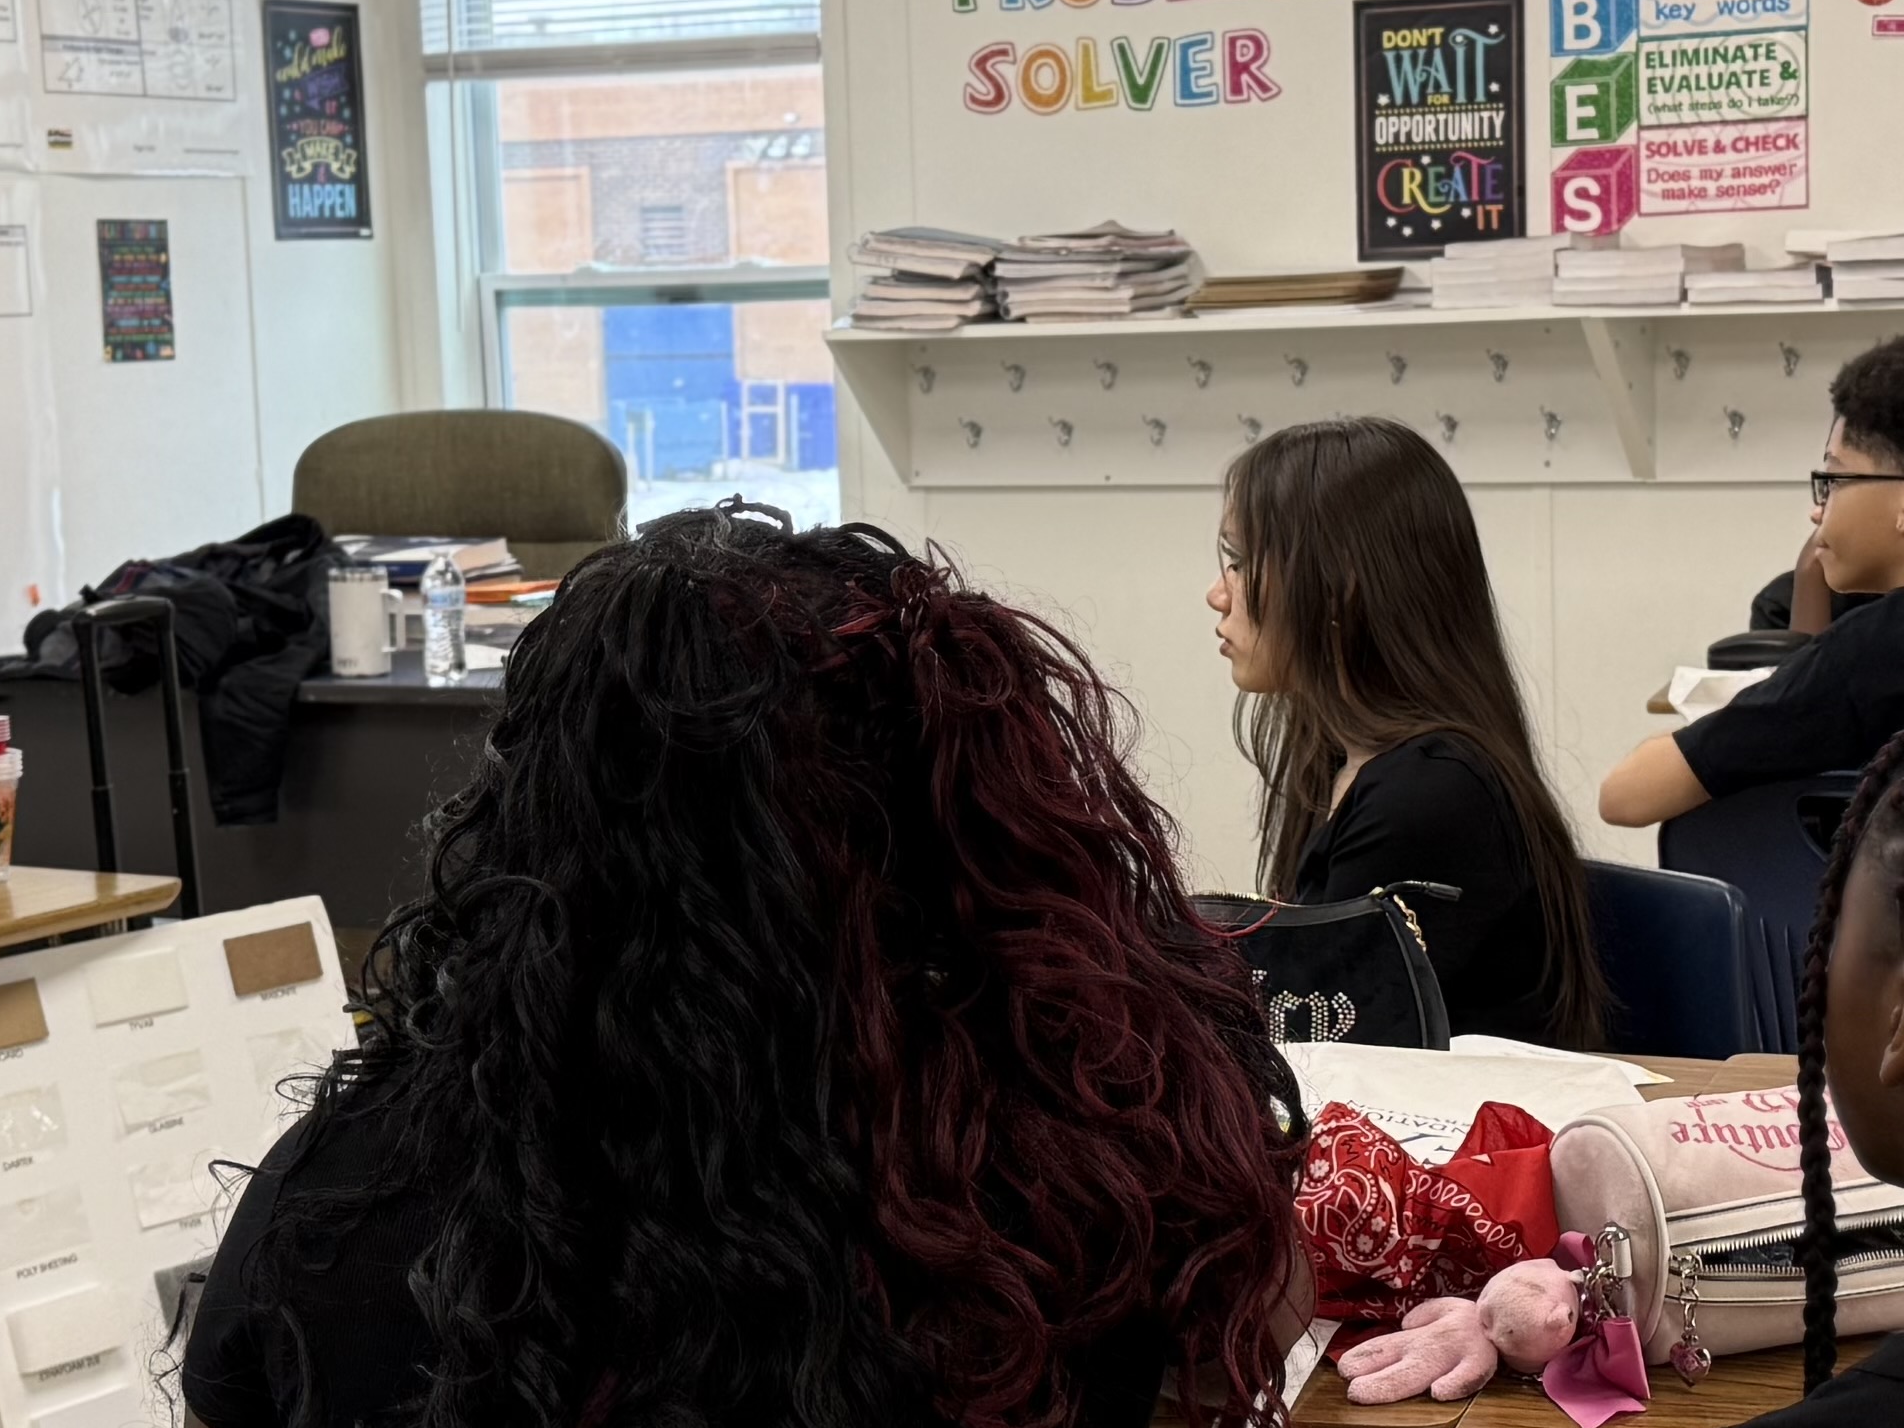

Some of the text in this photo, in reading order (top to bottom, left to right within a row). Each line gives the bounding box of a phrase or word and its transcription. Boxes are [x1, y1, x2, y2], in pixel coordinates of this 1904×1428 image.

[1654, 0, 1696, 22] key
[1381, 27, 1445, 50] DON'T
[1382, 28, 1505, 107] WAIT
[1644, 43, 1777, 70] ELIMINATE
[963, 28, 1281, 115] SOLVER
[1646, 60, 1797, 95] EVALUATE &
[1427, 94, 1450, 105] FOR
[1565, 84, 1600, 141] E
[1688, 97, 1722, 113] steps
[1726, 94, 1744, 109] do
[1375, 111, 1505, 144] OPPORTUNITY
[1645, 133, 1799, 159] SOLVE & CHECK
[1376, 151, 1505, 214] CREATE
[1646, 162, 1798, 184] Does my answer
[1661, 179, 1781, 201] make sense?
[1477, 204, 1504, 230] IT
[1564, 176, 1602, 233] S
